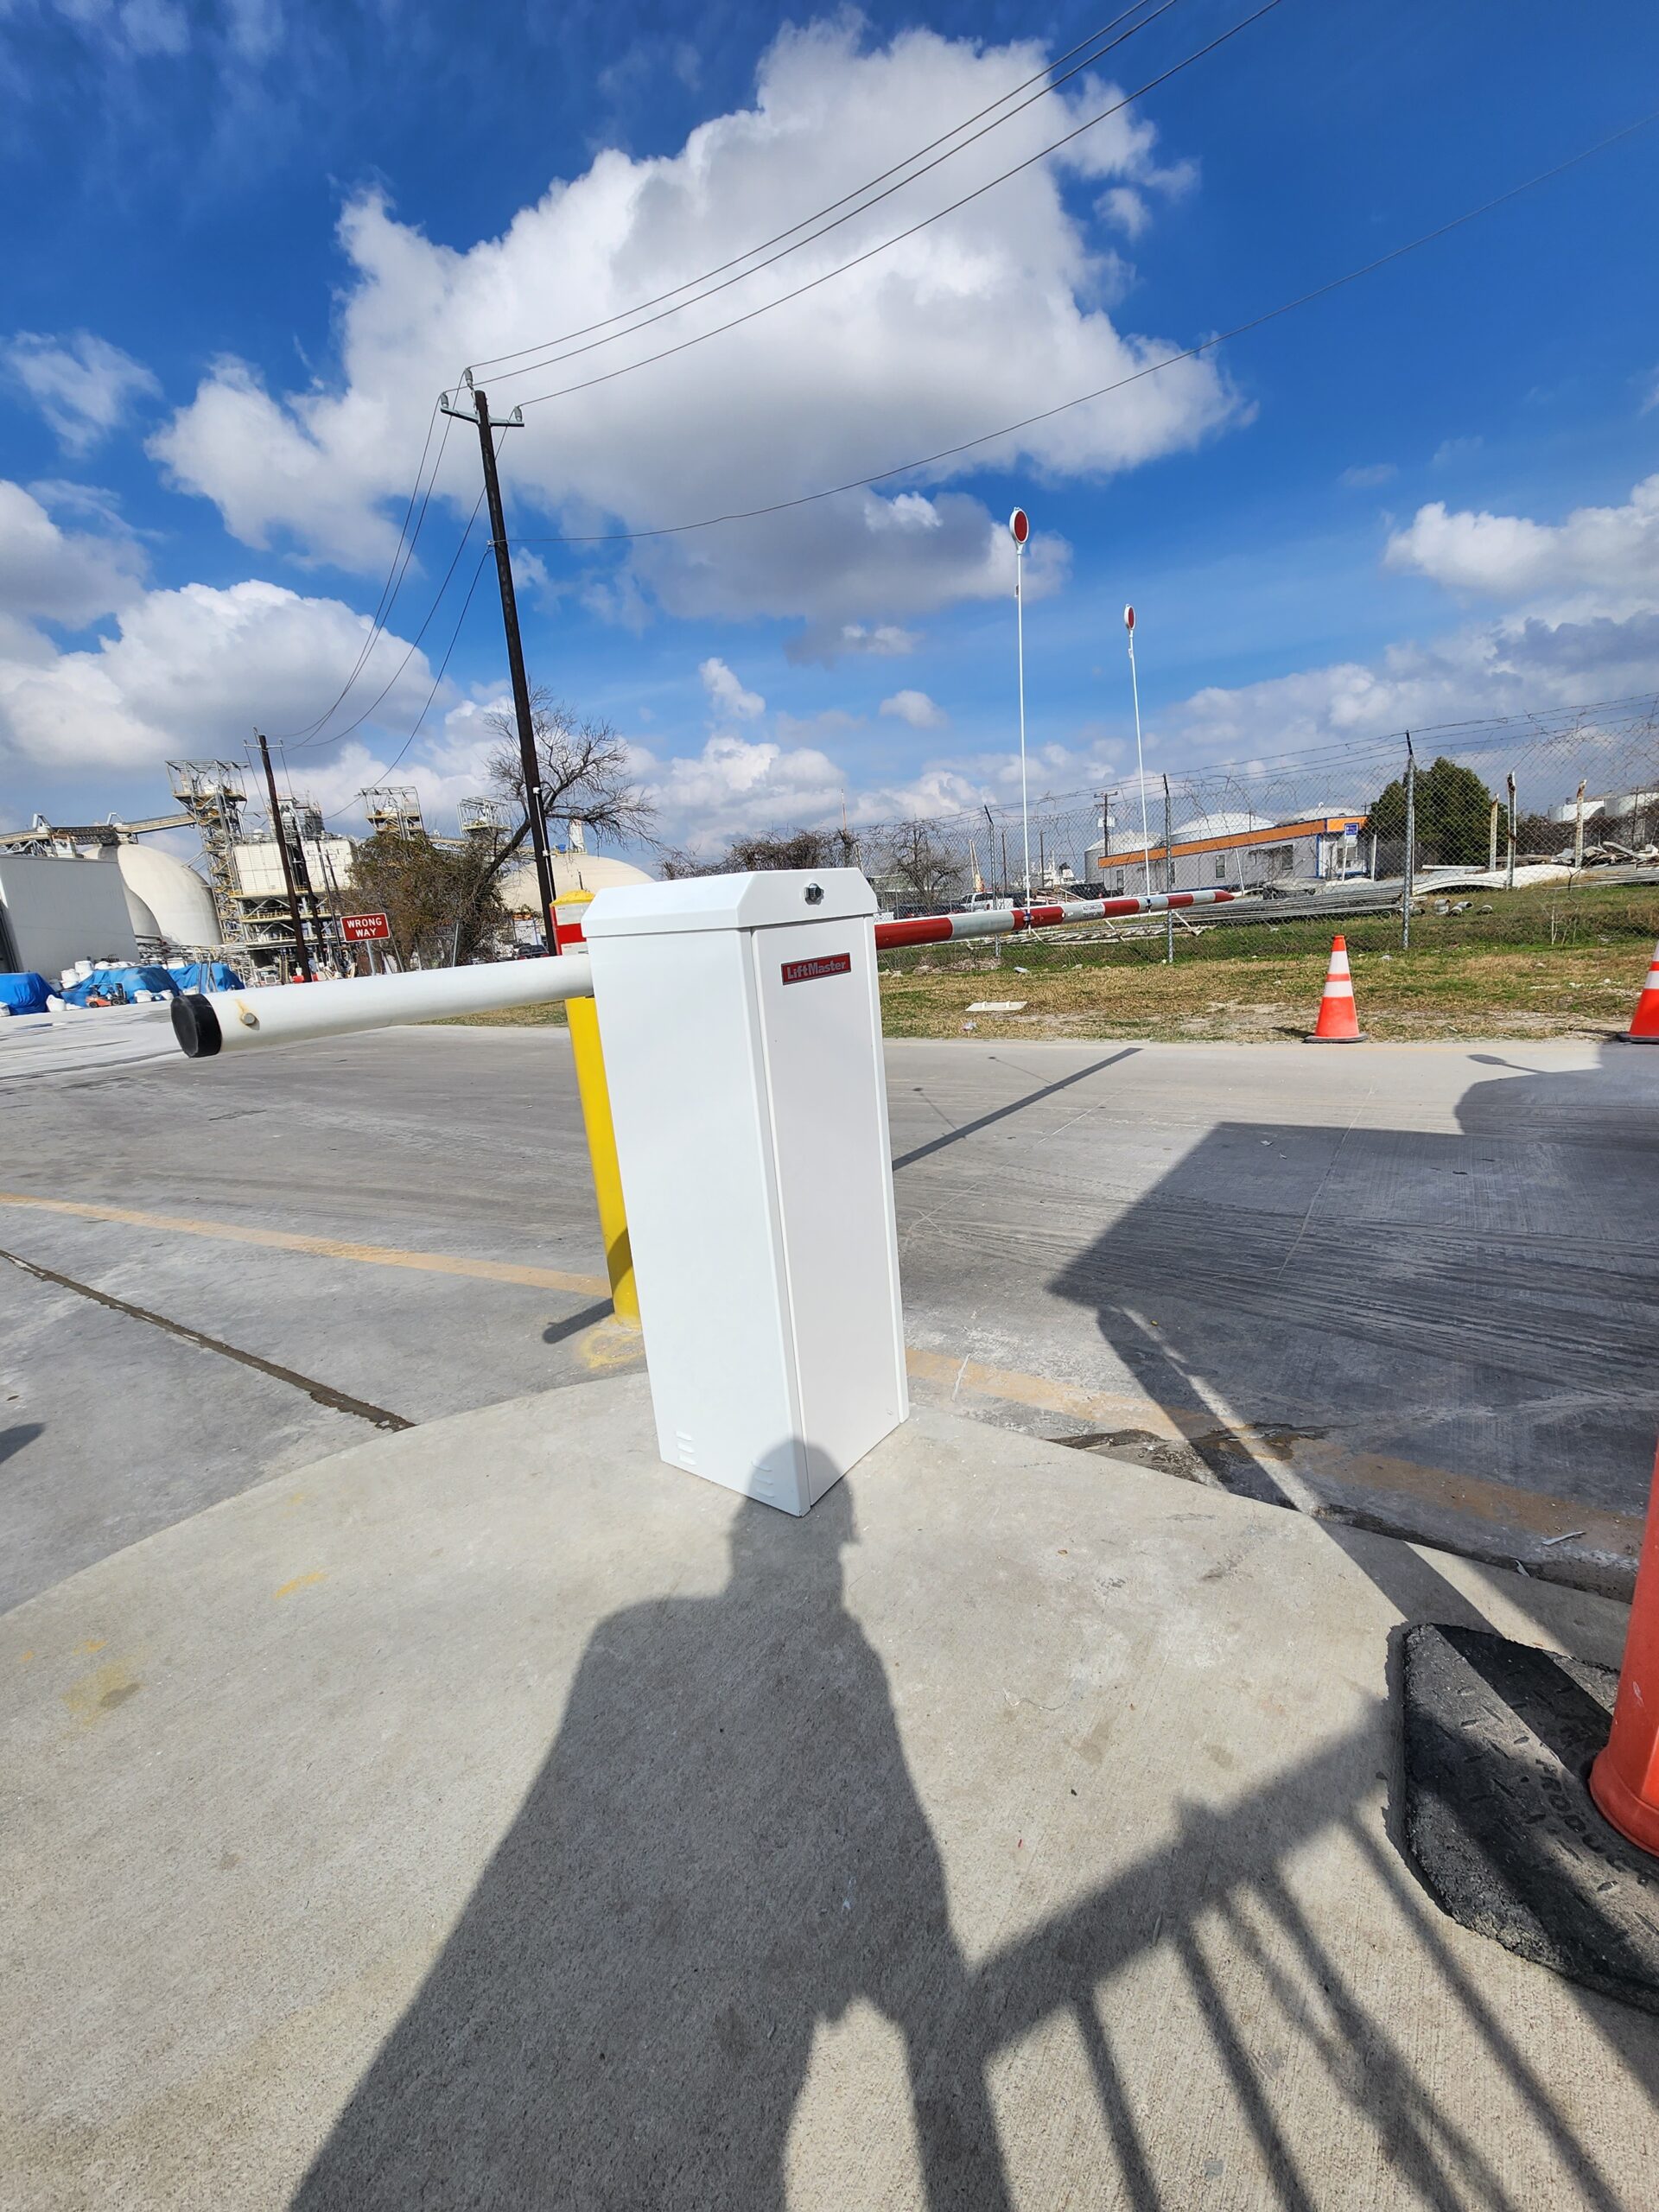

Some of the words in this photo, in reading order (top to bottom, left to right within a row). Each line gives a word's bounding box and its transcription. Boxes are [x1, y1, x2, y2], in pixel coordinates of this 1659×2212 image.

[346, 917, 382, 929] WRONG
[355, 927, 377, 938] WAY
[786, 960, 846, 980] LiftMaster
